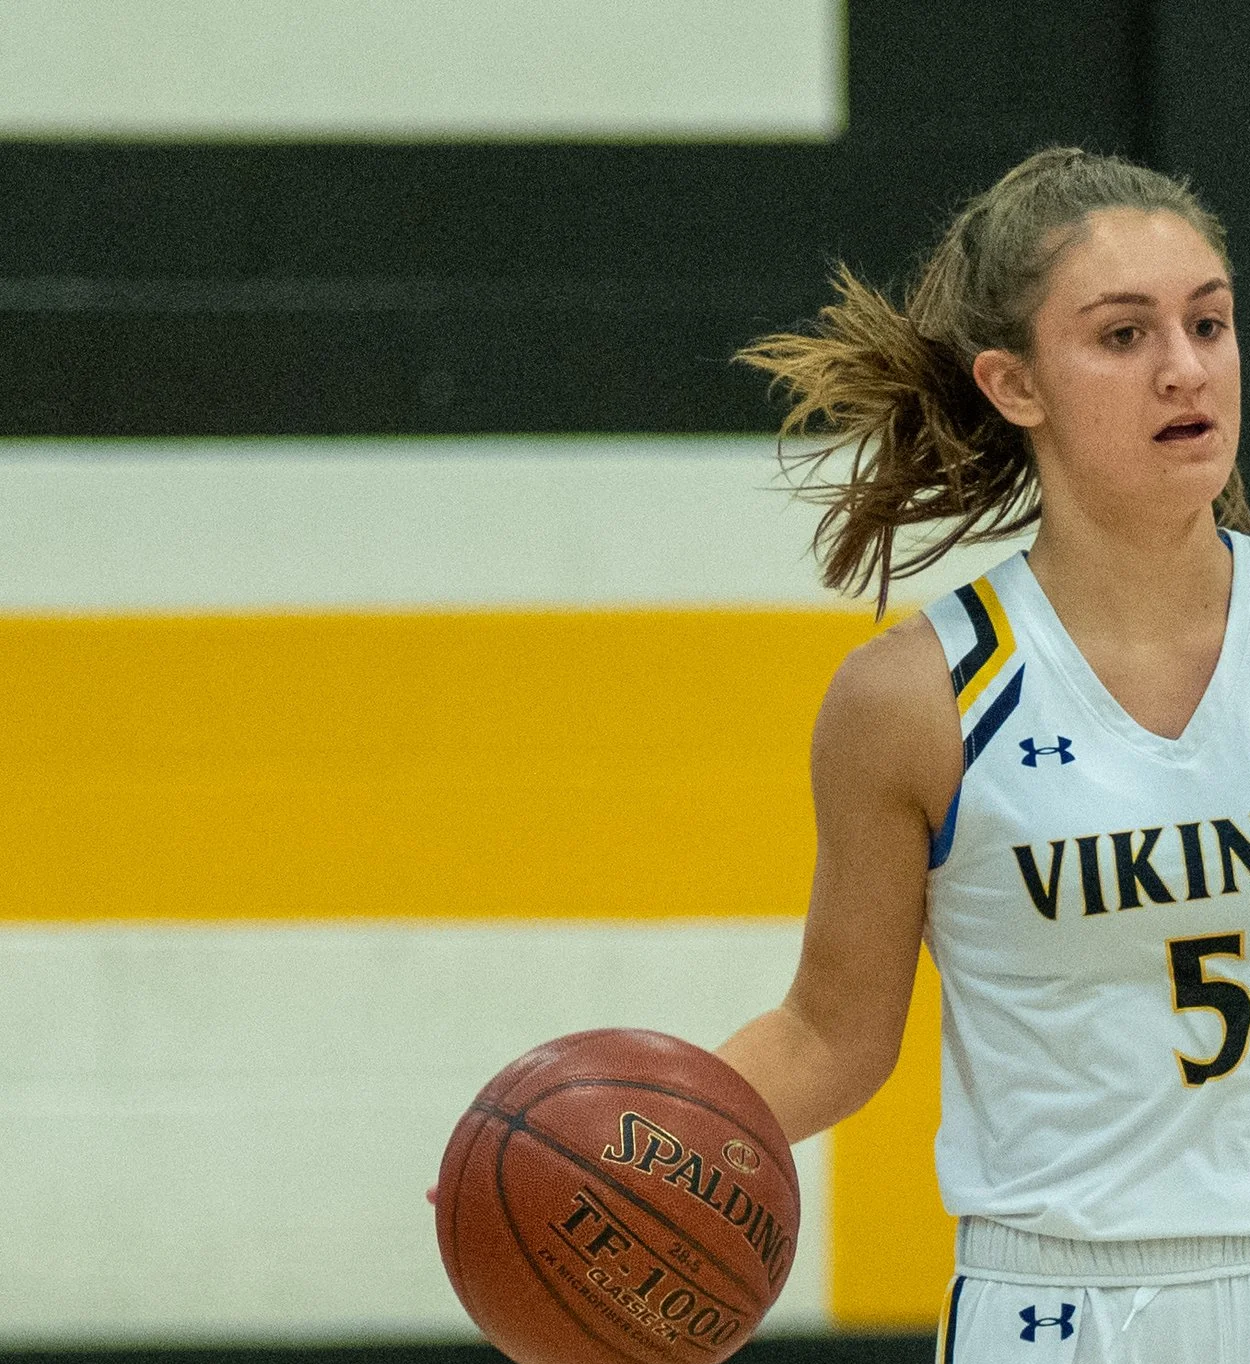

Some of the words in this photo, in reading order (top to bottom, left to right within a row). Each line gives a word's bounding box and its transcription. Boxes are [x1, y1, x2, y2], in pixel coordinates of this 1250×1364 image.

[560, 1190, 741, 1345] TF-1000
[601, 1111, 793, 1285] SPALDING
[586, 1266, 661, 1327] CLASSIC
